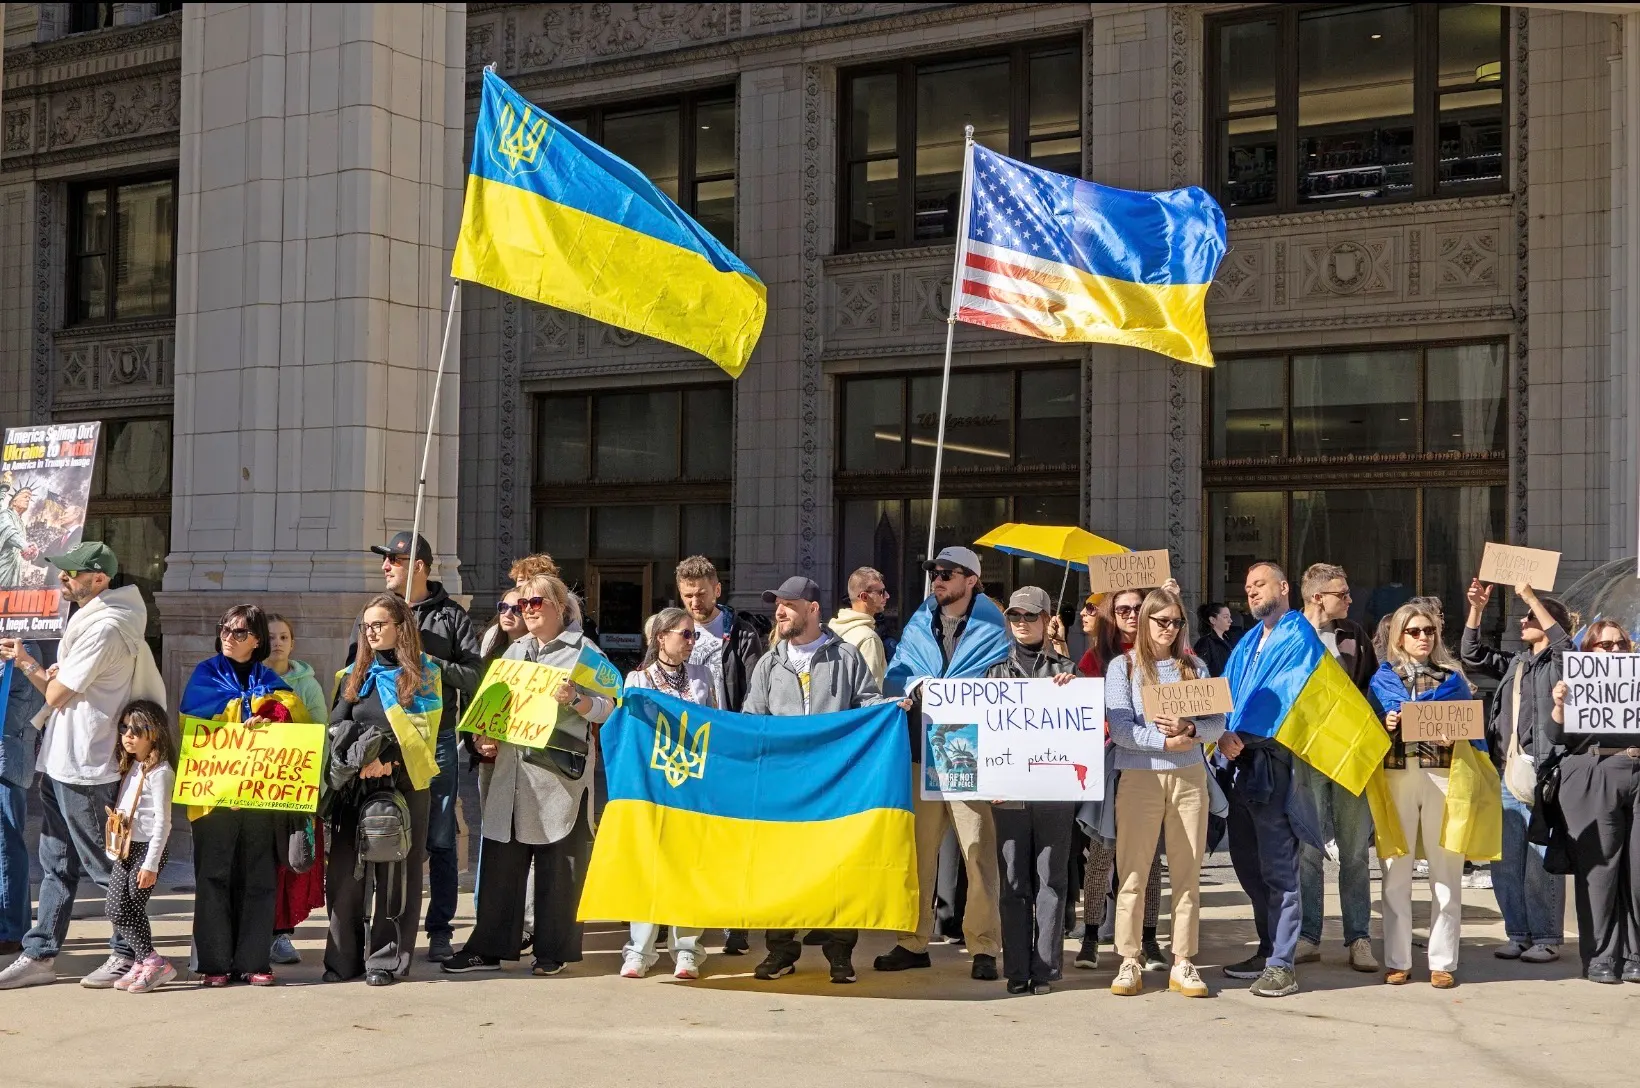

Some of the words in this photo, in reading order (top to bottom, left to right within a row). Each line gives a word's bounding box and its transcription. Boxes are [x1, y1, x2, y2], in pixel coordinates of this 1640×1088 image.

[7, 428, 46, 444] America
[46, 425, 77, 442] Selling
[78, 424, 94, 439] Out
[3, 443, 46, 461] Ukraine
[47, 441, 59, 457] to
[60, 439, 94, 457] Putin!
[1, 462, 11, 471] An
[11, 460, 37, 470] America
[44, 458, 70, 468] Trump's
[70, 458, 91, 467] Image
[1100, 556, 1127, 572] YOU
[1130, 555, 1156, 571] PAID
[1492, 550, 1514, 568] YOU
[1514, 556, 1539, 571] PAID
[1109, 573, 1134, 588] FOR
[1133, 572, 1156, 586] THIS
[6, 618, 29, 632] Inept,
[31, 617, 63, 632] Corrupt
[1567, 655, 1627, 679] DON'T
[927, 681, 1029, 707] SUPPORT
[1153, 685, 1182, 700] YOU
[1186, 684, 1215, 700] PAID
[500, 690, 533, 715] ON
[1162, 701, 1187, 714] FOR
[1187, 699, 1212, 712] THIS
[1415, 705, 1443, 721] YOU
[1448, 704, 1474, 721] PAID
[463, 697, 549, 741] OLESHKY
[986, 707, 1096, 731] UKRAINE
[1579, 707, 1616, 729] FOR
[1420, 721, 1443, 738] FOR
[1446, 721, 1469, 737] THIS
[249, 747, 316, 769] TRADE
[985, 748, 1015, 767] not
[960, 772, 975, 782] NOT
[179, 779, 215, 798] FOR
[237, 779, 319, 802] PROFIT
